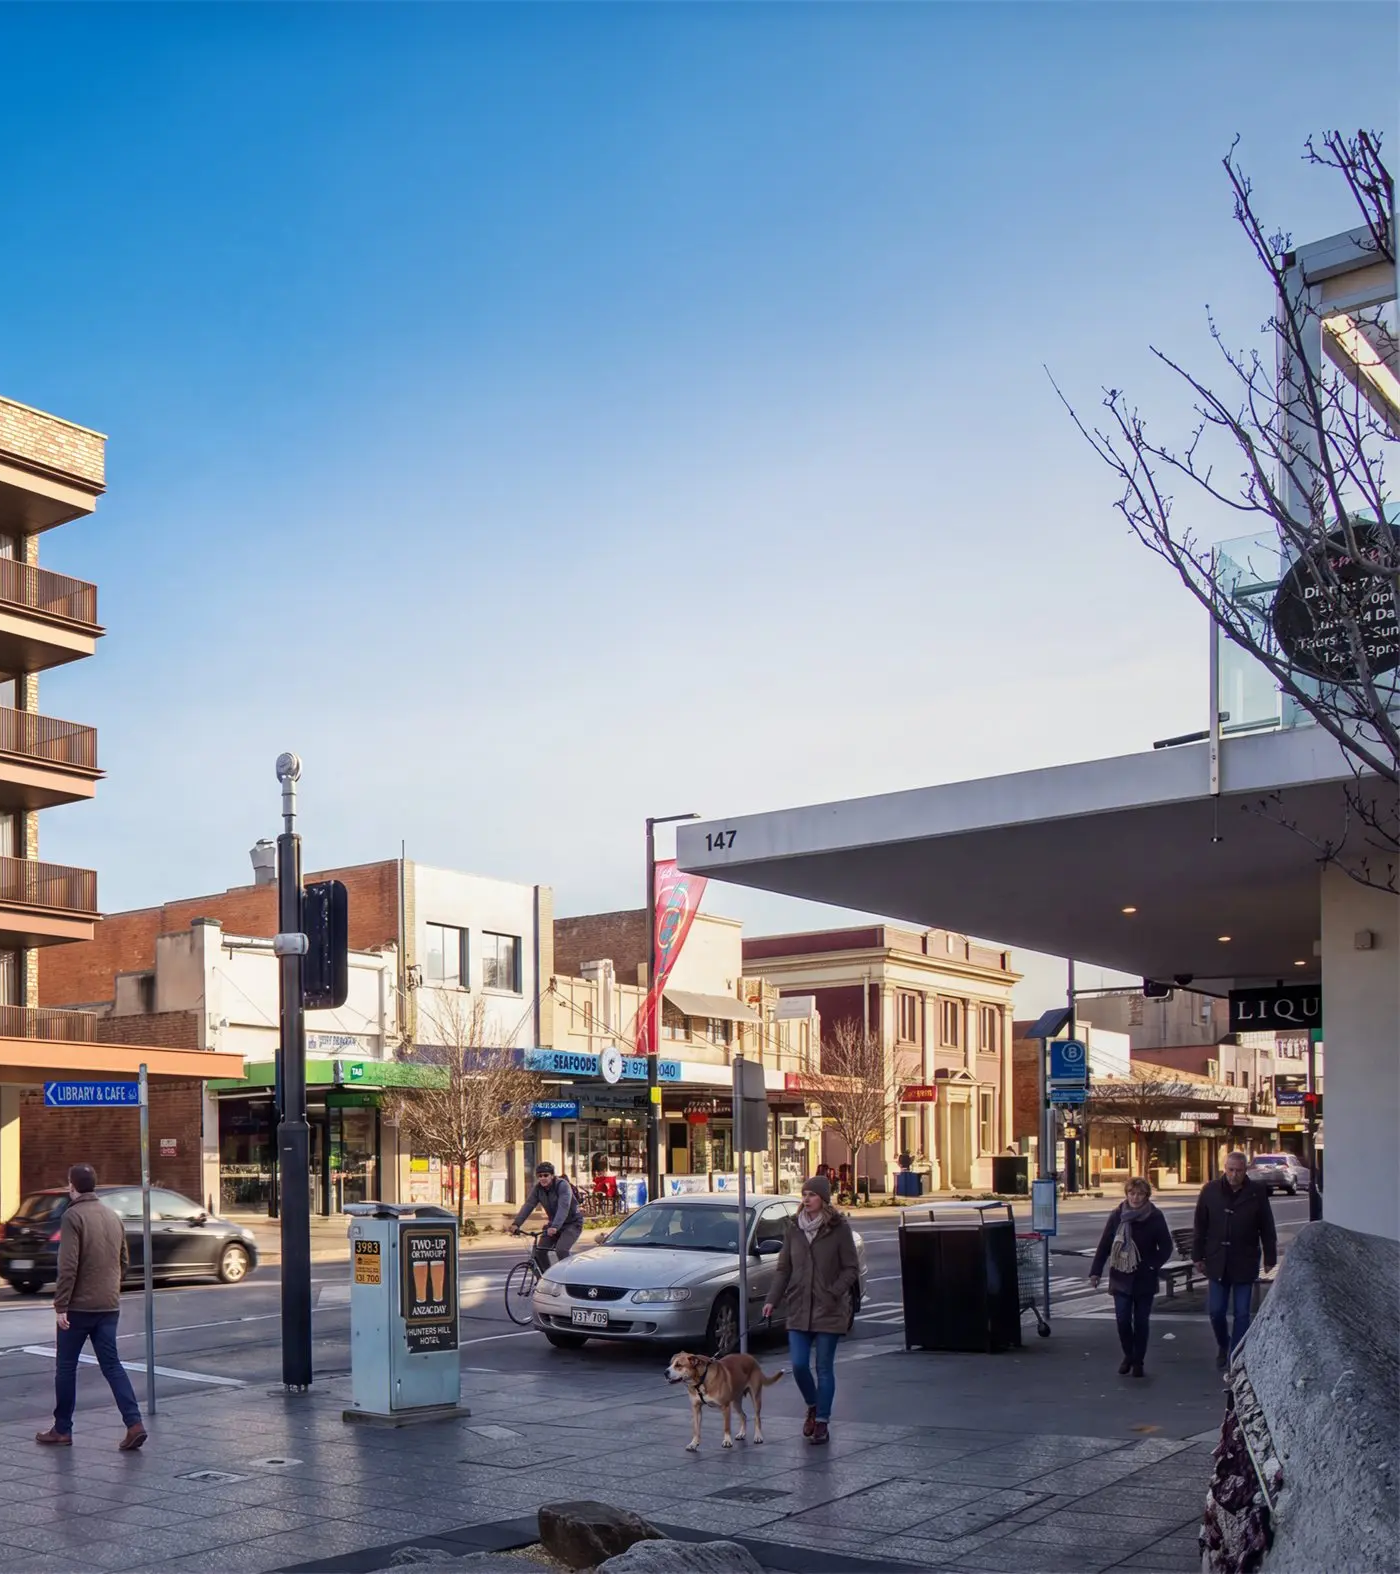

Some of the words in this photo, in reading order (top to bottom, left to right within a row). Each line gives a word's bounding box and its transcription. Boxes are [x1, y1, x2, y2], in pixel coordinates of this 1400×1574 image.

[1363, 611, 1371, 622] 4
[705, 830, 737, 851] 147
[554, 1054, 597, 1072] SEAFOODS
[657, 1063, 676, 1078] 040
[352, 1067, 363, 1076] TAB
[57, 1086, 95, 1101] LIBRARY
[96, 1086, 103, 1101] &
[105, 1086, 126, 1101] CAFE
[356, 1241, 379, 1254] 3983
[366, 1274, 380, 1283] 700
[412, 1306, 433, 1315] ANZAC
[433, 1305, 447, 1314] DAY
[408, 1326, 437, 1336] HUNTERS
[438, 1326, 452, 1335] HILL
[420, 1336, 440, 1345] HOTEL
